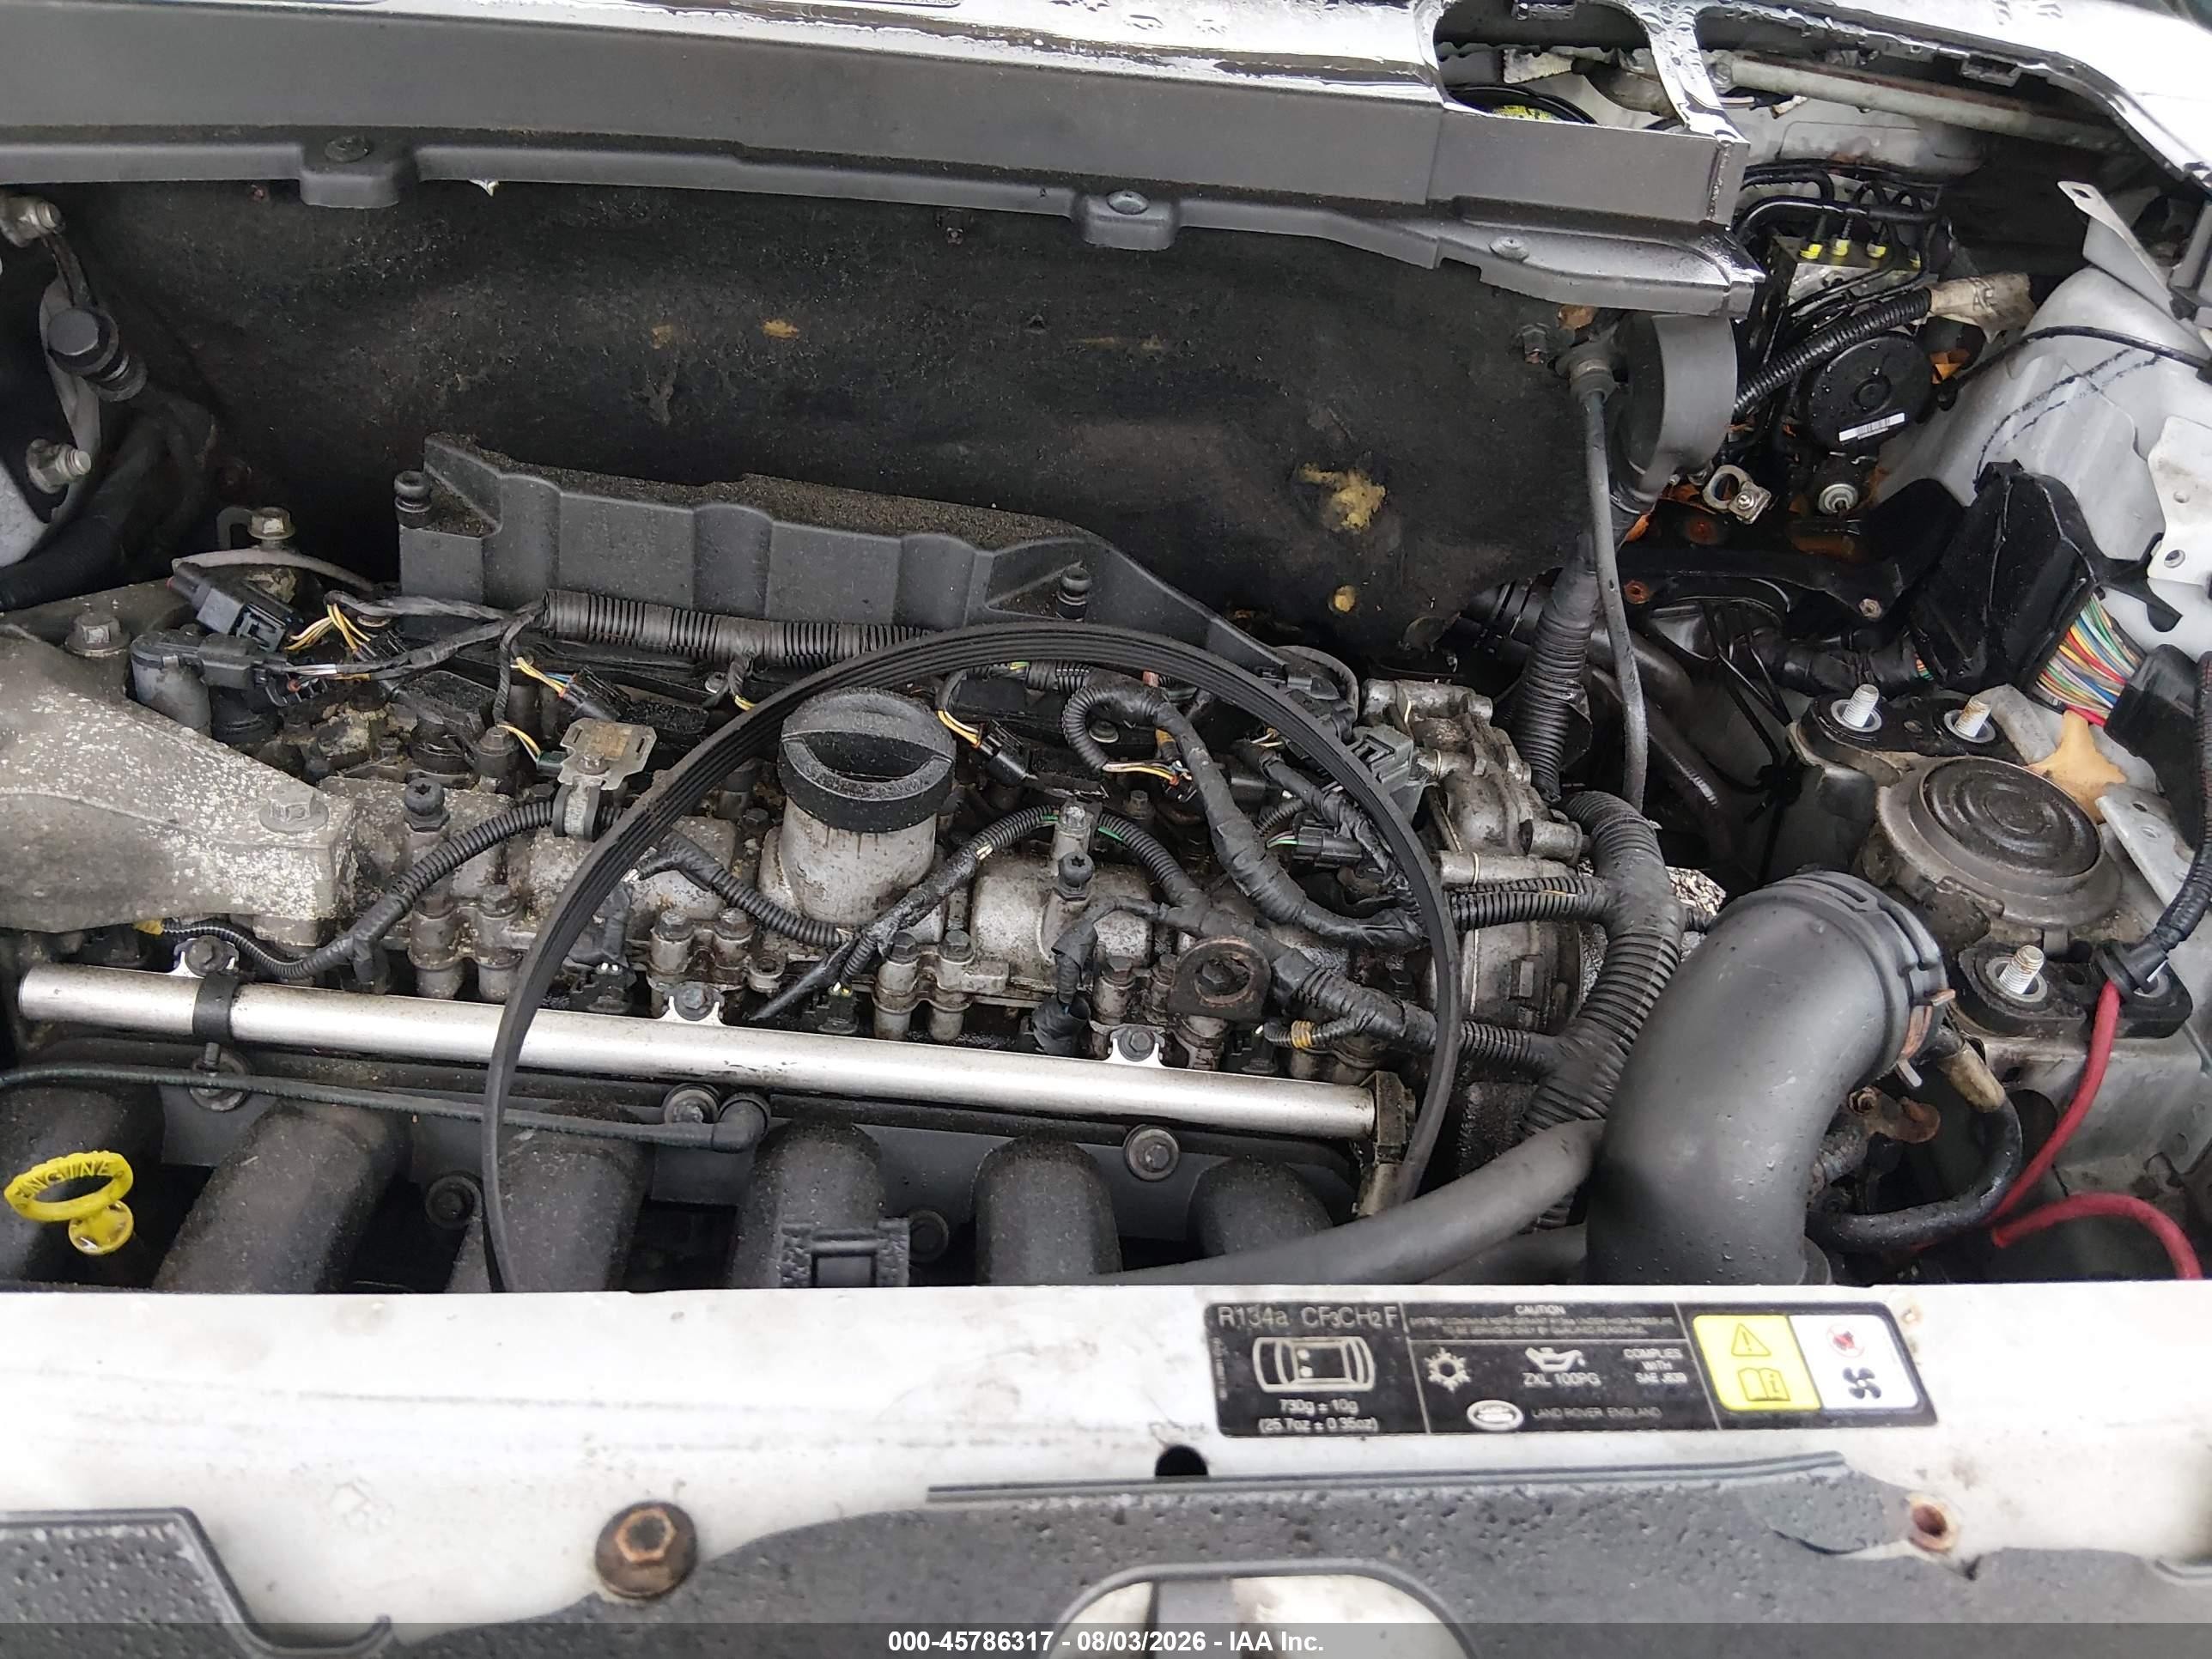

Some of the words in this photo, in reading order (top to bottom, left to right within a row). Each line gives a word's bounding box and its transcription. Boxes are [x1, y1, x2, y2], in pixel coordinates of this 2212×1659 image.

[14, 1159, 115, 1200] ENGINE
[1218, 1305, 1291, 1328] R134a
[1514, 1304, 1566, 1316] CAUTION
[1622, 1348, 1685, 1360] COMPLIES
[1522, 1372, 1553, 1389] ZXL
[1331, 1397, 1359, 1416] 10g
